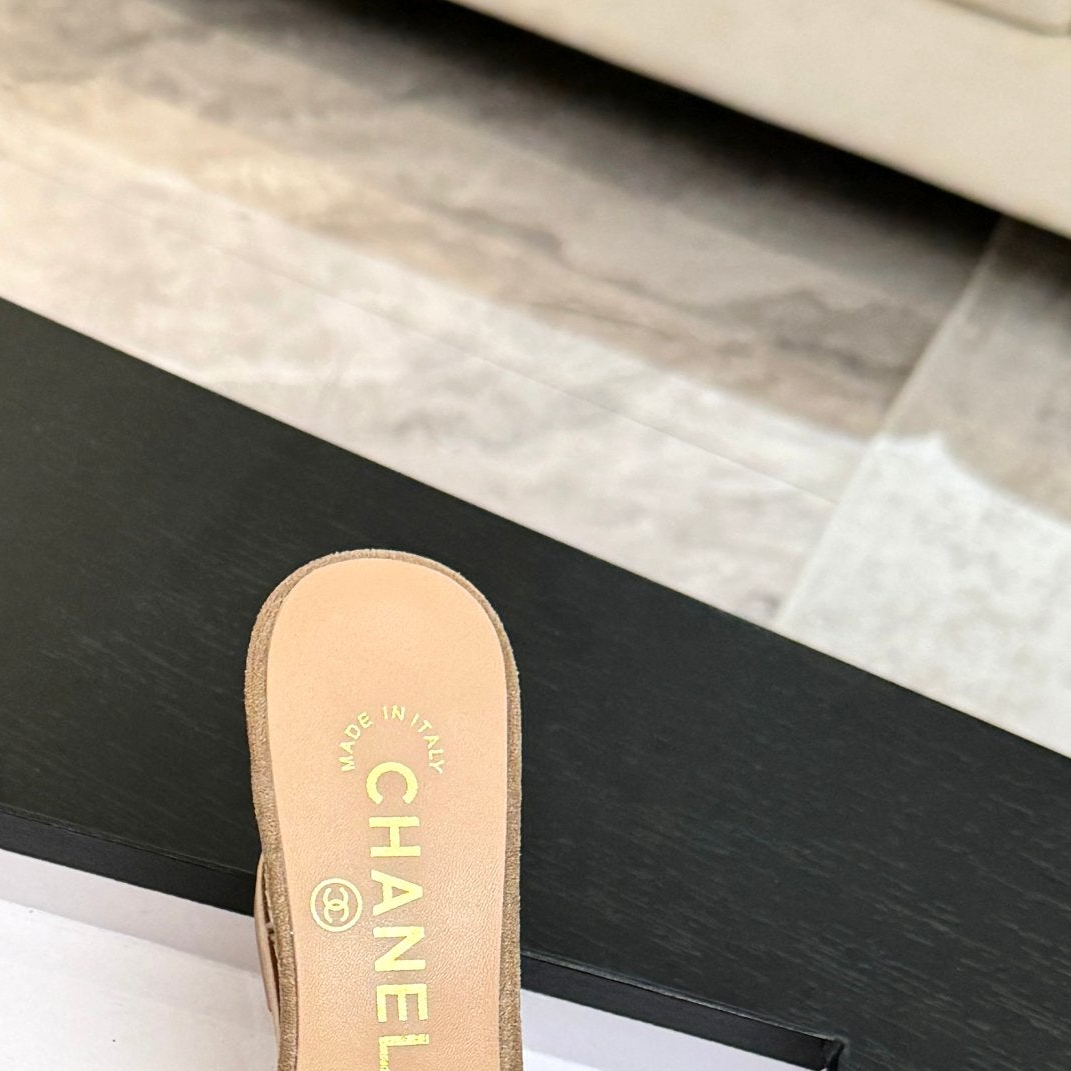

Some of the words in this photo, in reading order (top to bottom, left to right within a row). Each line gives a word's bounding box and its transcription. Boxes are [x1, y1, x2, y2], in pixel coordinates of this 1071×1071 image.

[338, 712, 373, 772] MADE
[382, 704, 406, 721] IN
[410, 712, 445, 774] ITALY
